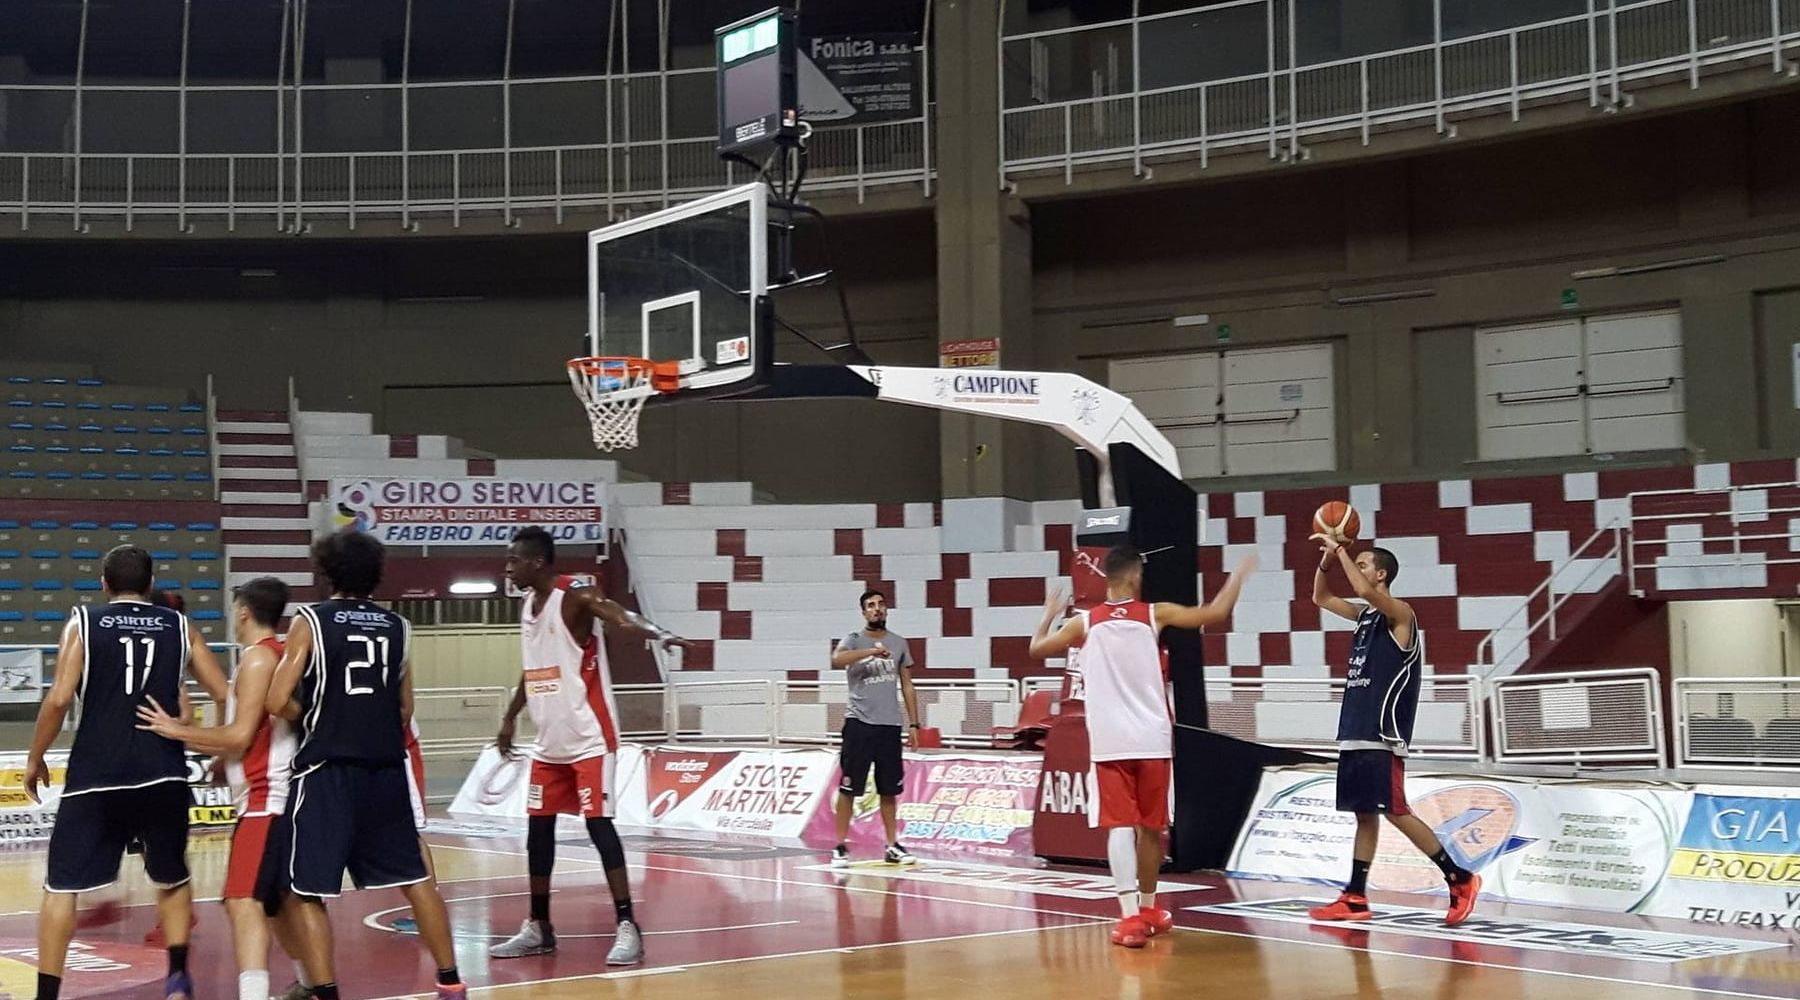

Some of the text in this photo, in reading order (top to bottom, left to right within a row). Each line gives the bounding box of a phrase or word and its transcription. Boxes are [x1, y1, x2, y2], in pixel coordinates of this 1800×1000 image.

[811, 36, 875, 59] Fonica
[954, 375, 1040, 395] CAMPIONE
[382, 481, 596, 504] GIRO SERVICE
[382, 508, 447, 521] STAMPA
[449, 508, 517, 521] DIGITALE
[529, 508, 596, 521] INSEGNE
[385, 525, 471, 541] FABBRO
[480, 524, 577, 541] AGLO
[114, 615, 165, 627] SIRTEC
[118, 636, 156, 695] 17
[344, 635, 389, 695] 21
[733, 764, 808, 789] STORE
[702, 789, 813, 815] MARTINEZ
[1711, 808, 1800, 843] GIA
[1523, 853, 1647, 875] Isolamento termico
[1690, 853, 1800, 882] PRODUZ
